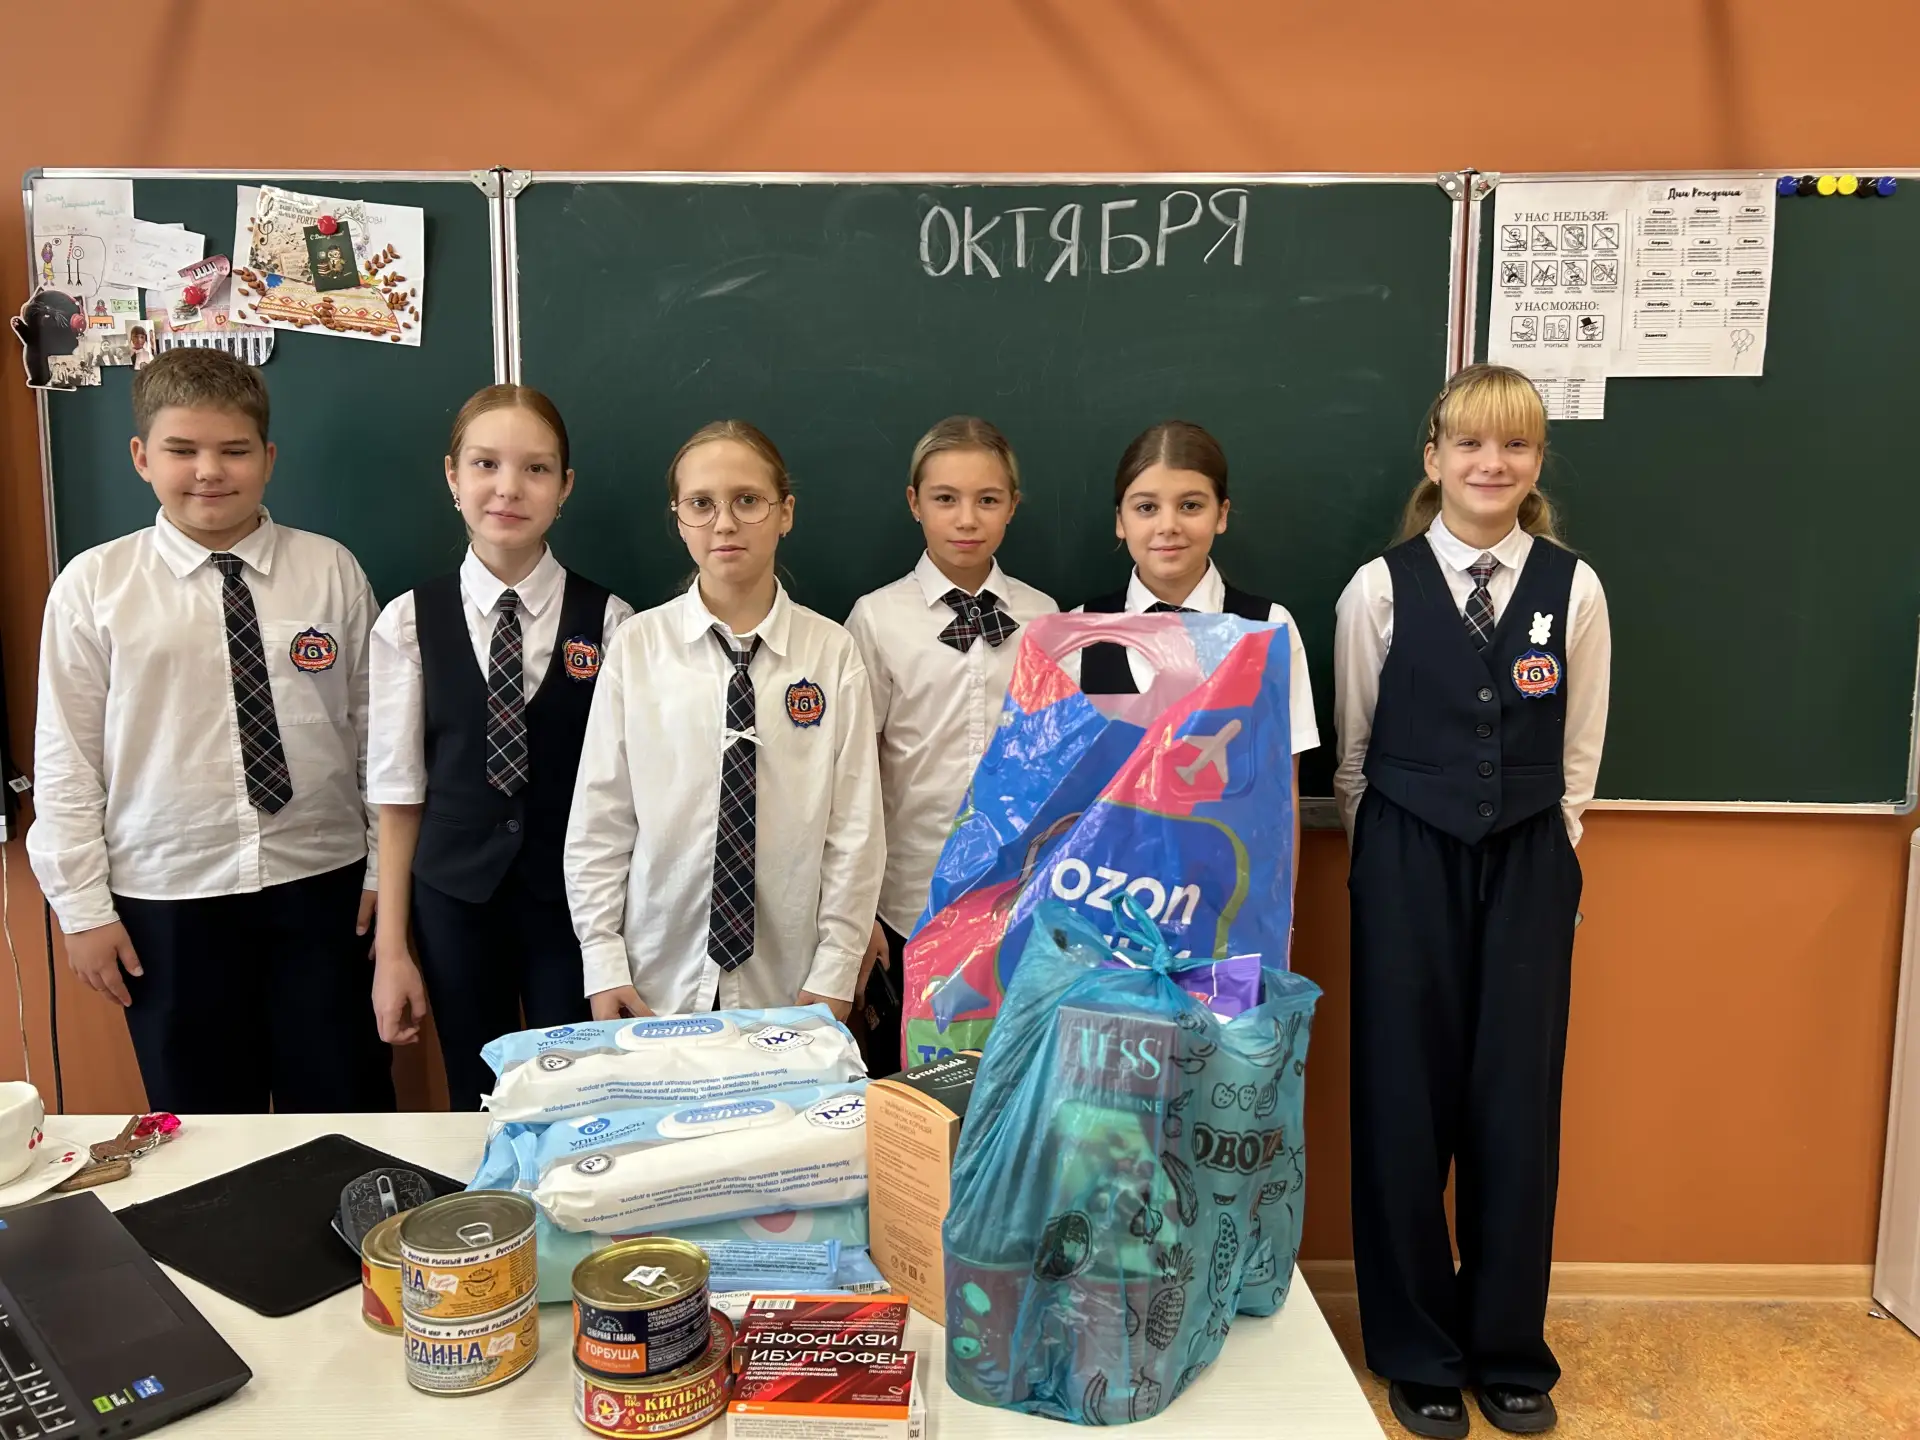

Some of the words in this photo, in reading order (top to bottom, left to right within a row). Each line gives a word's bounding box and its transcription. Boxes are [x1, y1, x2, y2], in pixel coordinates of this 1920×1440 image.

[1514, 213, 1521, 222] У
[1525, 213, 1549, 222] НАС
[1554, 211, 1608, 222] НЕЛЬЗЯ:
[920, 188, 1249, 282] ОКТЯБРЯ
[1515, 302, 1522, 312] У
[1524, 302, 1548, 312] НАС
[1550, 302, 1600, 311] МОЖНО:
[308, 646, 318, 658] 6
[574, 654, 584, 666] 6
[1530, 668, 1542, 681] 6
[800, 698, 808, 711] 6
[642, 1024, 714, 1036] Salfeti
[1072, 1026, 1160, 1080] TESS
[686, 1106, 765, 1122] Salfeti
[816, 1100, 866, 1120] XXL
[569, 1121, 645, 1147] ПОЛОТЕНЦА
[826, 1160, 850, 1168] Удобны
[780, 1173, 810, 1183] содержат
[811, 1177, 838, 1186] бережно
[613, 1333, 636, 1342] ГАВАНЬ
[744, 1332, 898, 1346] ИБУПРОФЕН
[586, 1341, 640, 1360] ГОРБУША
[751, 1350, 908, 1364] ИБУПРОФЕН
[742, 1382, 774, 1392] 400
[645, 1378, 716, 1411] КИЛЬКА
[636, 1386, 722, 1424] ОБЖАРЕННАЯ
